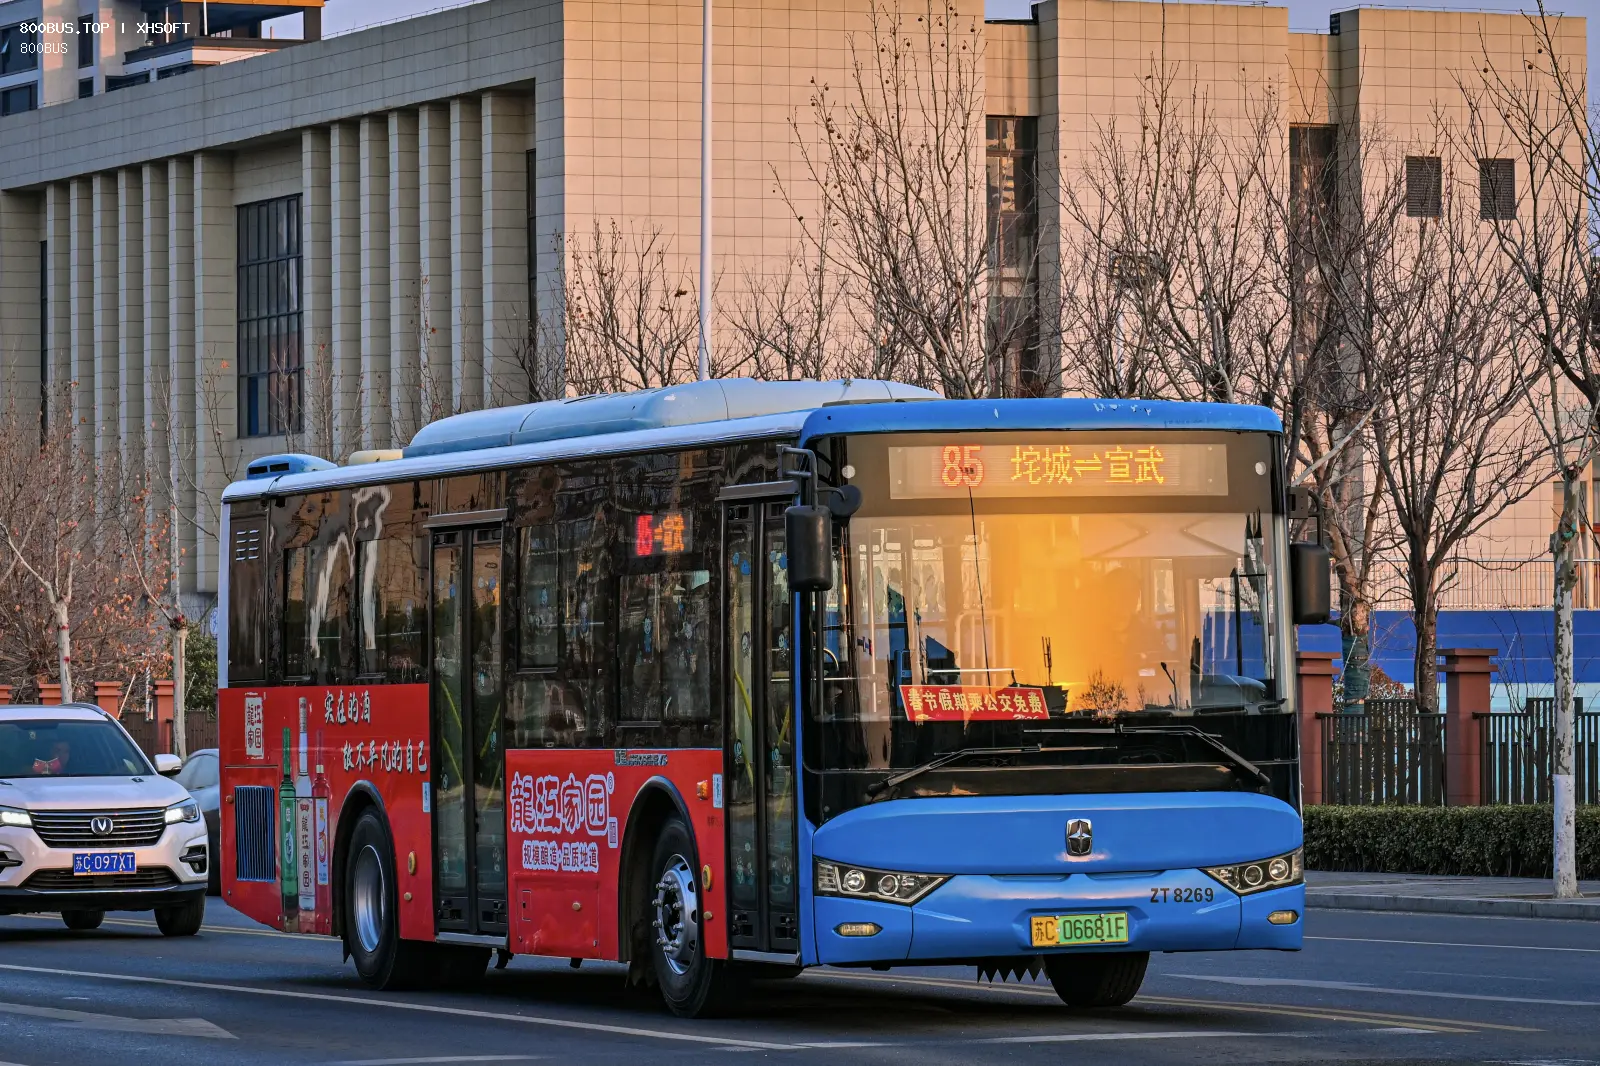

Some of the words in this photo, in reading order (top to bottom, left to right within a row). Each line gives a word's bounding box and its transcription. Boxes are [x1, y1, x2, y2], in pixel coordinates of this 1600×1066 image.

[941, 445, 984, 487] 85
[1010, 445, 1073, 485] 垞城
[1105, 445, 1164, 484] 宣武
[324, 689, 371, 724] 实在的酒
[907, 686, 1044, 714] 春节假期乘公交免费
[1150, 887, 1170, 903] ZT
[1173, 887, 1214, 903] 8269
